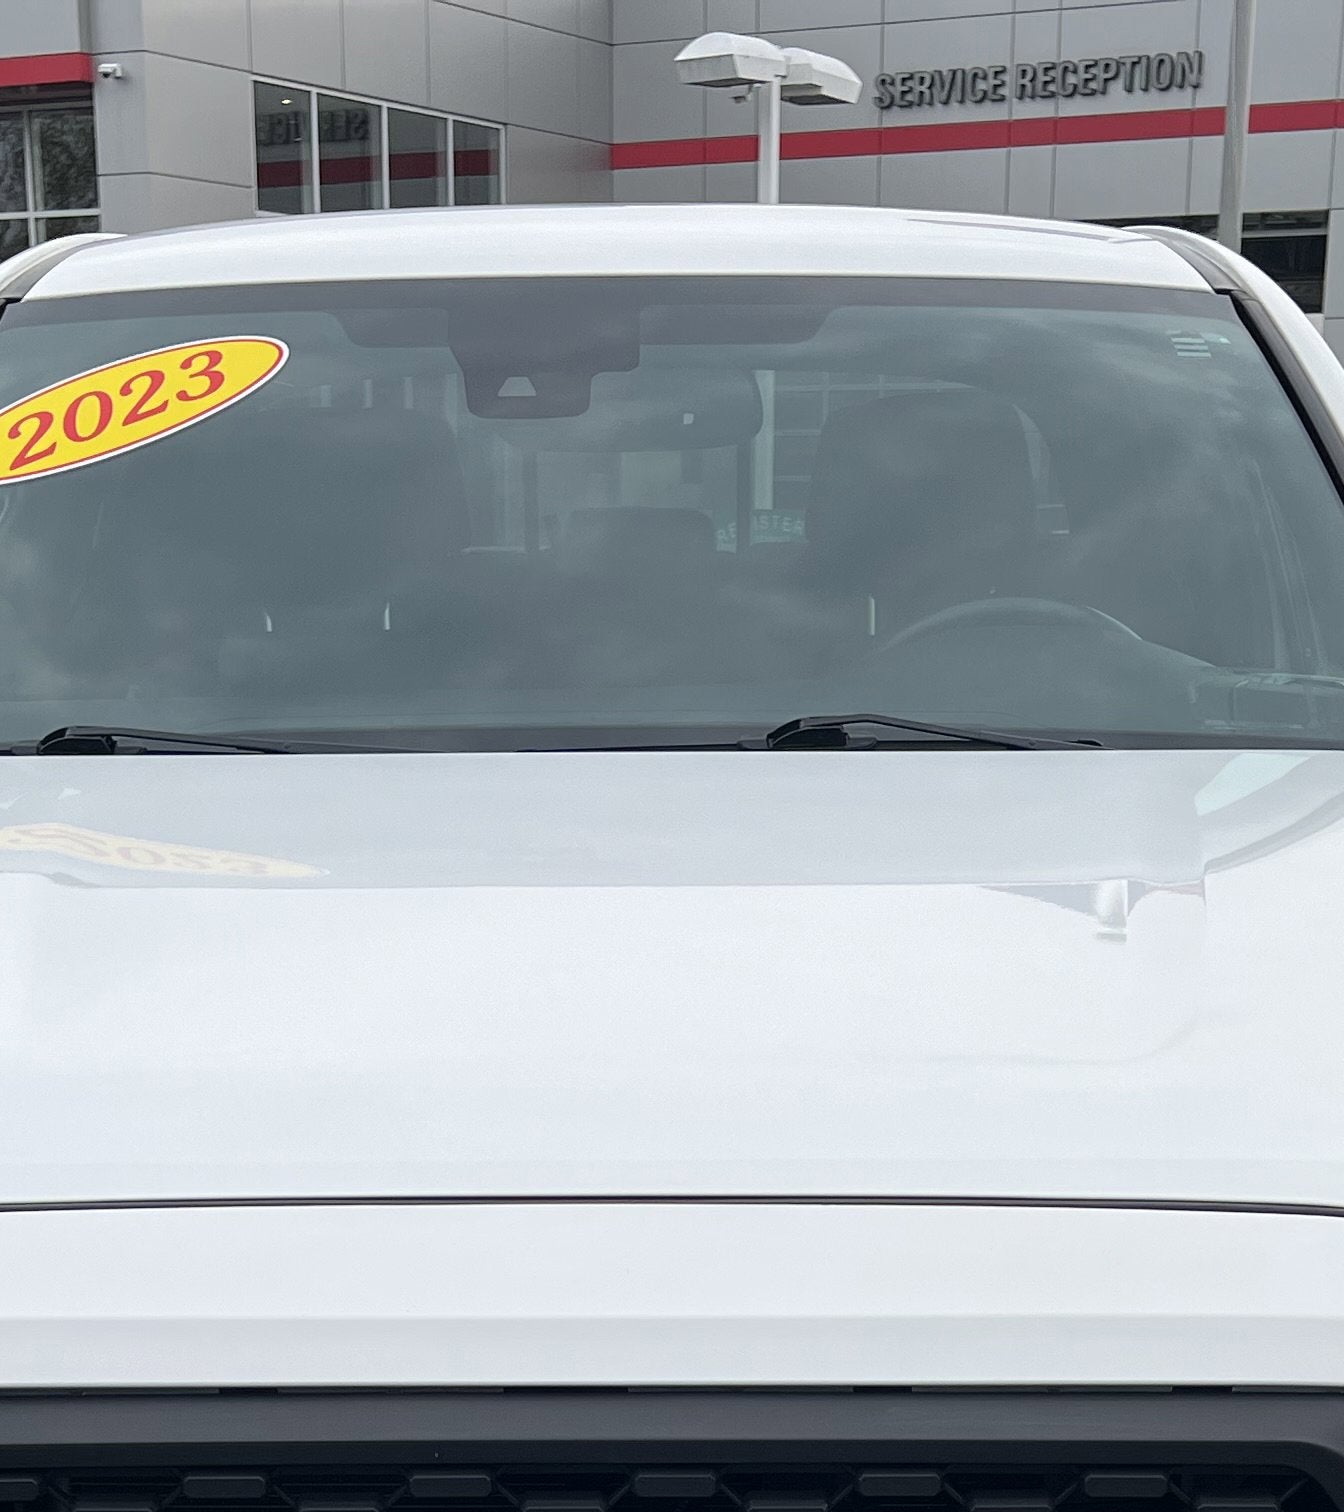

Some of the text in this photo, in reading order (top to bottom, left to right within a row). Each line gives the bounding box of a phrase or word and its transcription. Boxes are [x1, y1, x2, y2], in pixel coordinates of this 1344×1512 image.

[873, 50, 1204, 110] SERVICE RECEPTION
[7, 349, 226, 471] 2023
[716, 514, 806, 541] REISTER
